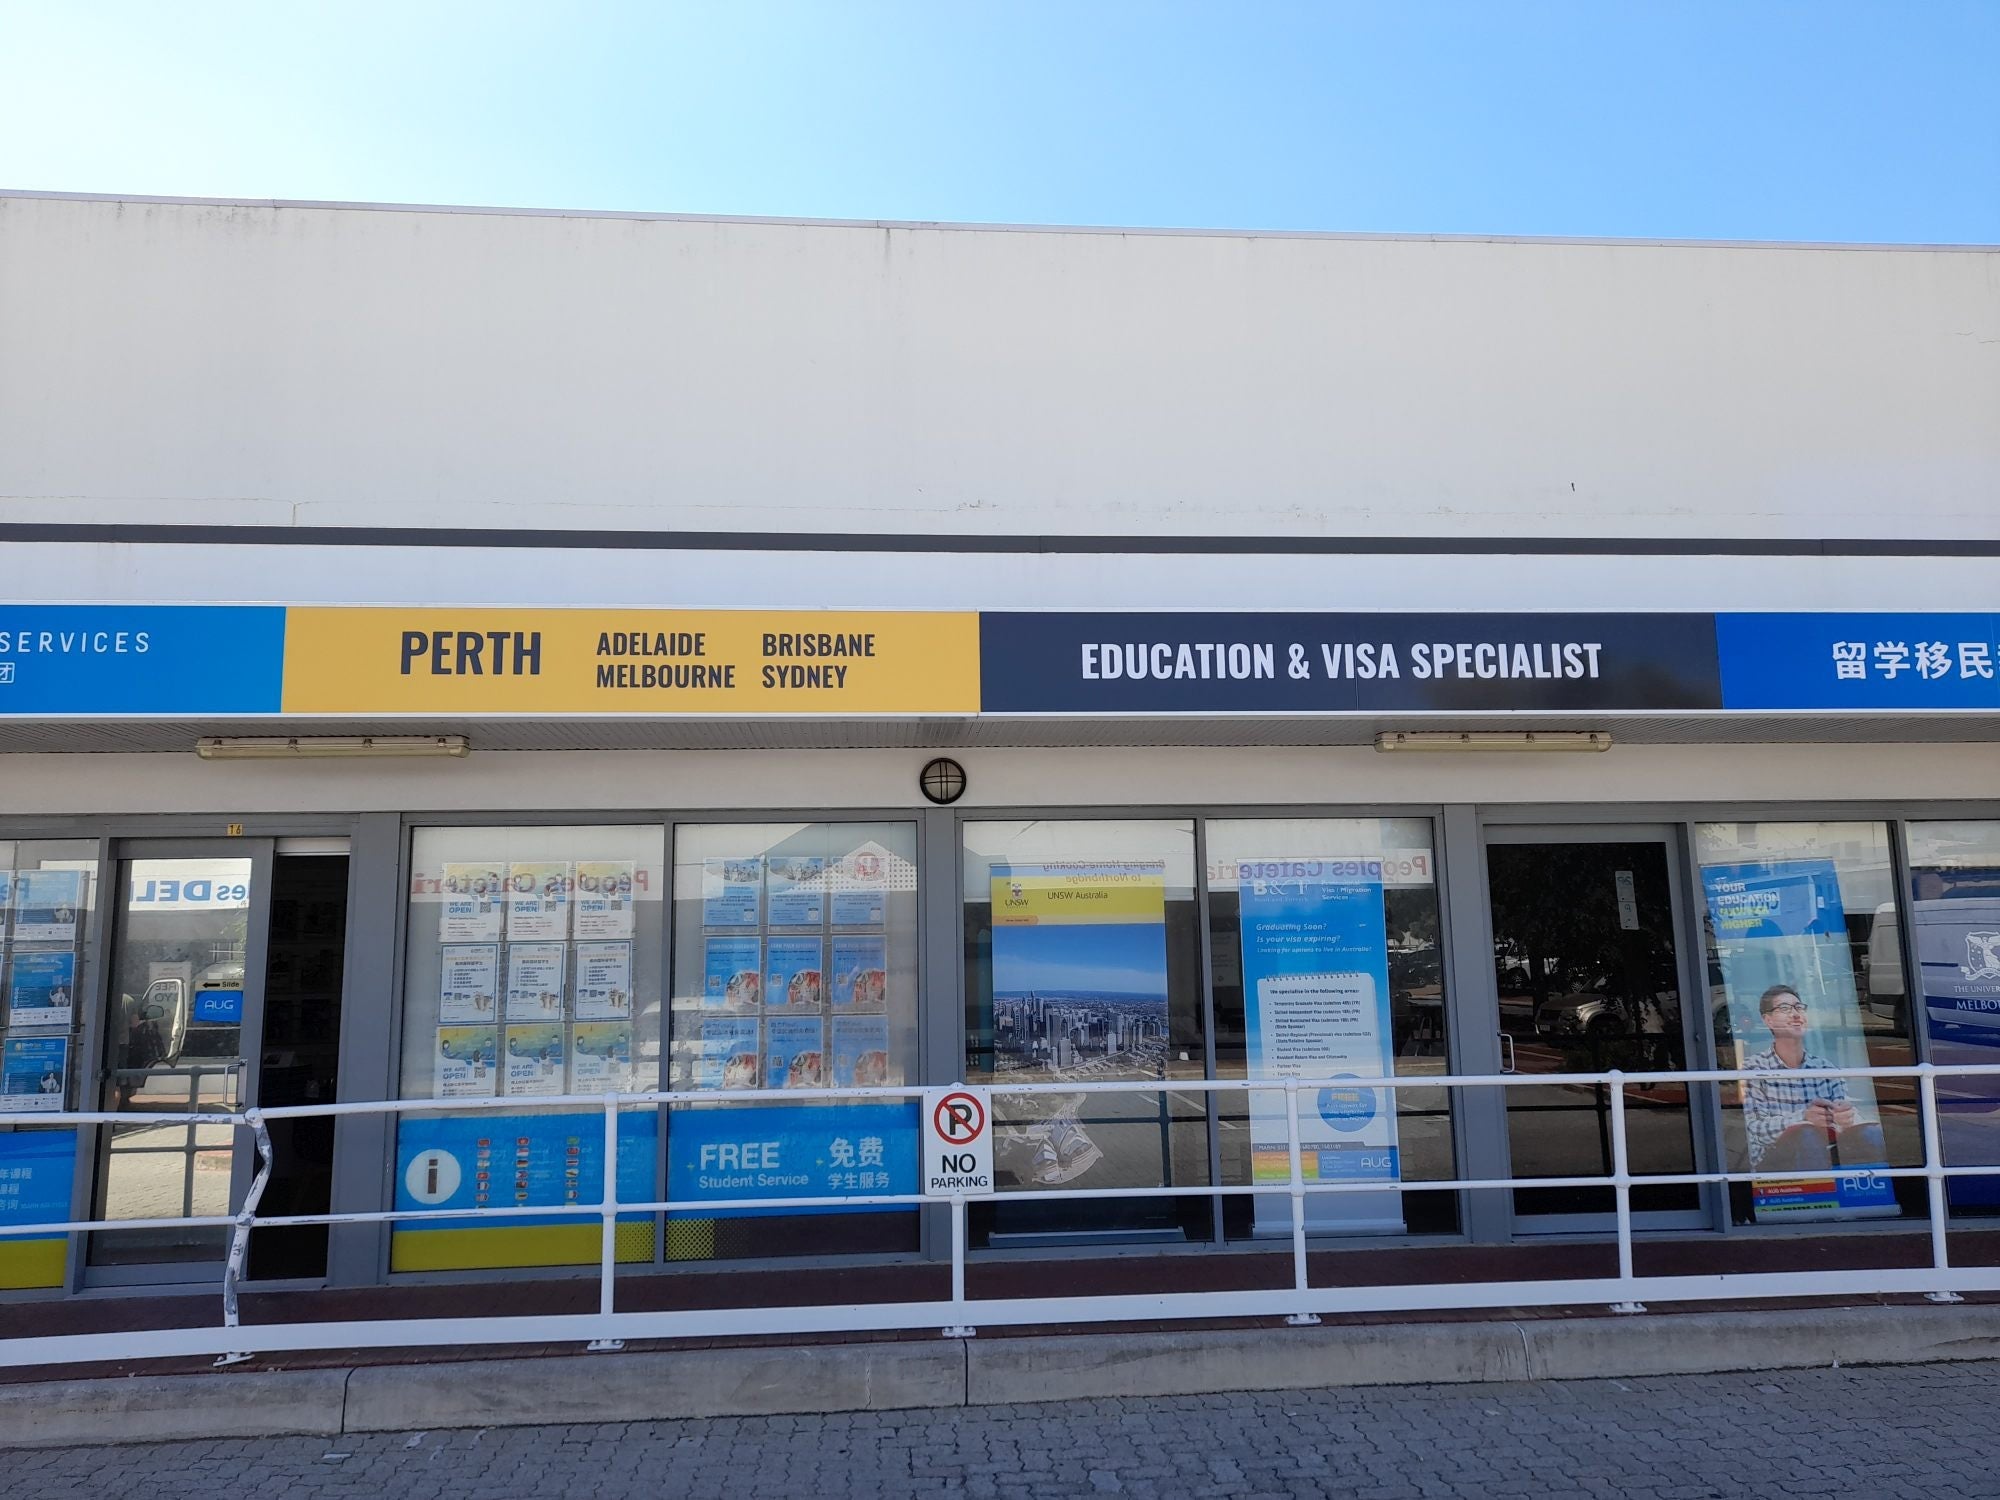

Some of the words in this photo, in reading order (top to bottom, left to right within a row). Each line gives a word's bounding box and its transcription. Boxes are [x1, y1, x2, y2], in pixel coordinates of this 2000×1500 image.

[0, 631, 151, 654] SERVICES
[596, 632, 706, 656] ADELAIDE
[762, 633, 875, 657] BRISBANE
[400, 631, 541, 675] PERTH
[1081, 643, 1275, 680] EDUCATION
[1287, 643, 1310, 680] &
[1321, 643, 1400, 679] VISA
[1411, 642, 1602, 679] SPECIALIST
[1832, 640, 2000, 680] 留学移民
[596, 664, 736, 689] MELBOURNE
[761, 664, 848, 689] SYDNEY
[230, 825, 241, 835] 16
[1047, 891, 1073, 900] UNSW
[1075, 890, 1109, 900] Australia
[1715, 882, 1746, 892] YOUR
[1717, 893, 1780, 905] EDUCATION
[449, 906, 472, 914] OPEN
[1256, 923, 1301, 932] Graduating
[1256, 935, 1264, 943] Is
[1265, 936, 1284, 945] your
[1286, 935, 1302, 943] visa
[1303, 935, 1341, 945] expiring?
[1970, 985, 2000, 993] UNIVER
[204, 999, 234, 1010] AUG
[699, 1141, 781, 1171] FREE
[828, 1136, 885, 1169] 免费
[942, 1153, 976, 1174] NO
[1361, 1157, 1392, 1168] AUG
[699, 1173, 755, 1189] Student
[757, 1173, 809, 1187] Service
[827, 1171, 890, 1190] 学生服务
[930, 1174, 989, 1189] PARKING
[1843, 1176, 1886, 1192] AUG
